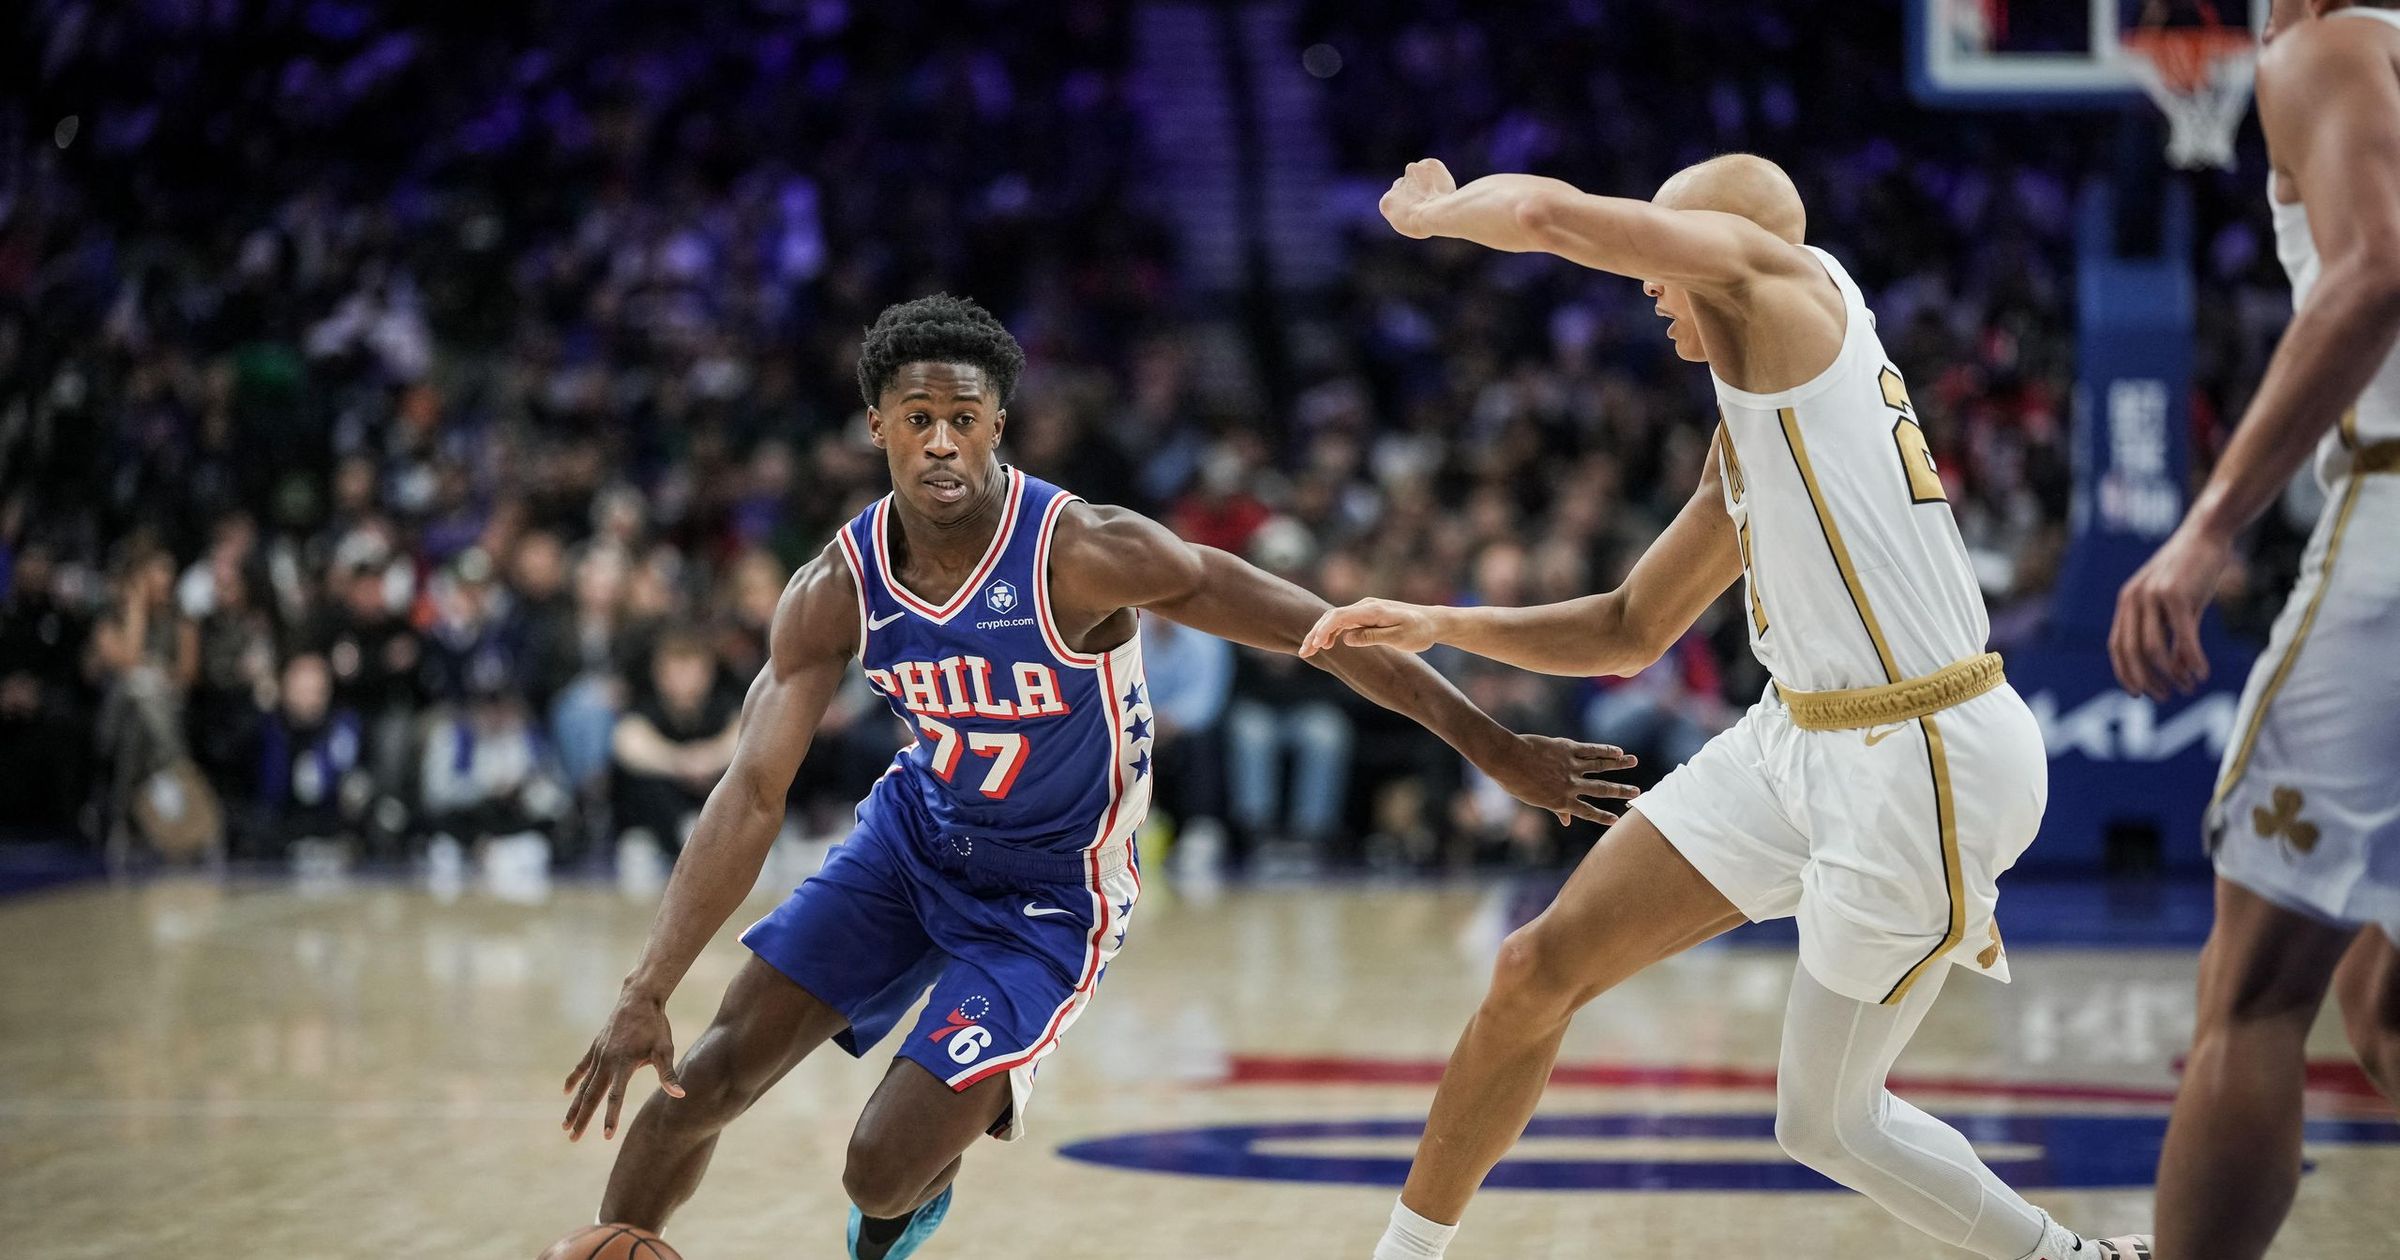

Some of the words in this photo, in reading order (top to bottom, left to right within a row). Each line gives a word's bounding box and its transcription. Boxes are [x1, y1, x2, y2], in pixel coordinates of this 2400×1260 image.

[976, 617, 1034, 630] crypto.com
[864, 655, 1071, 721] PHILA
[918, 713, 1031, 800] 77
[928, 1005, 993, 1065] 76
